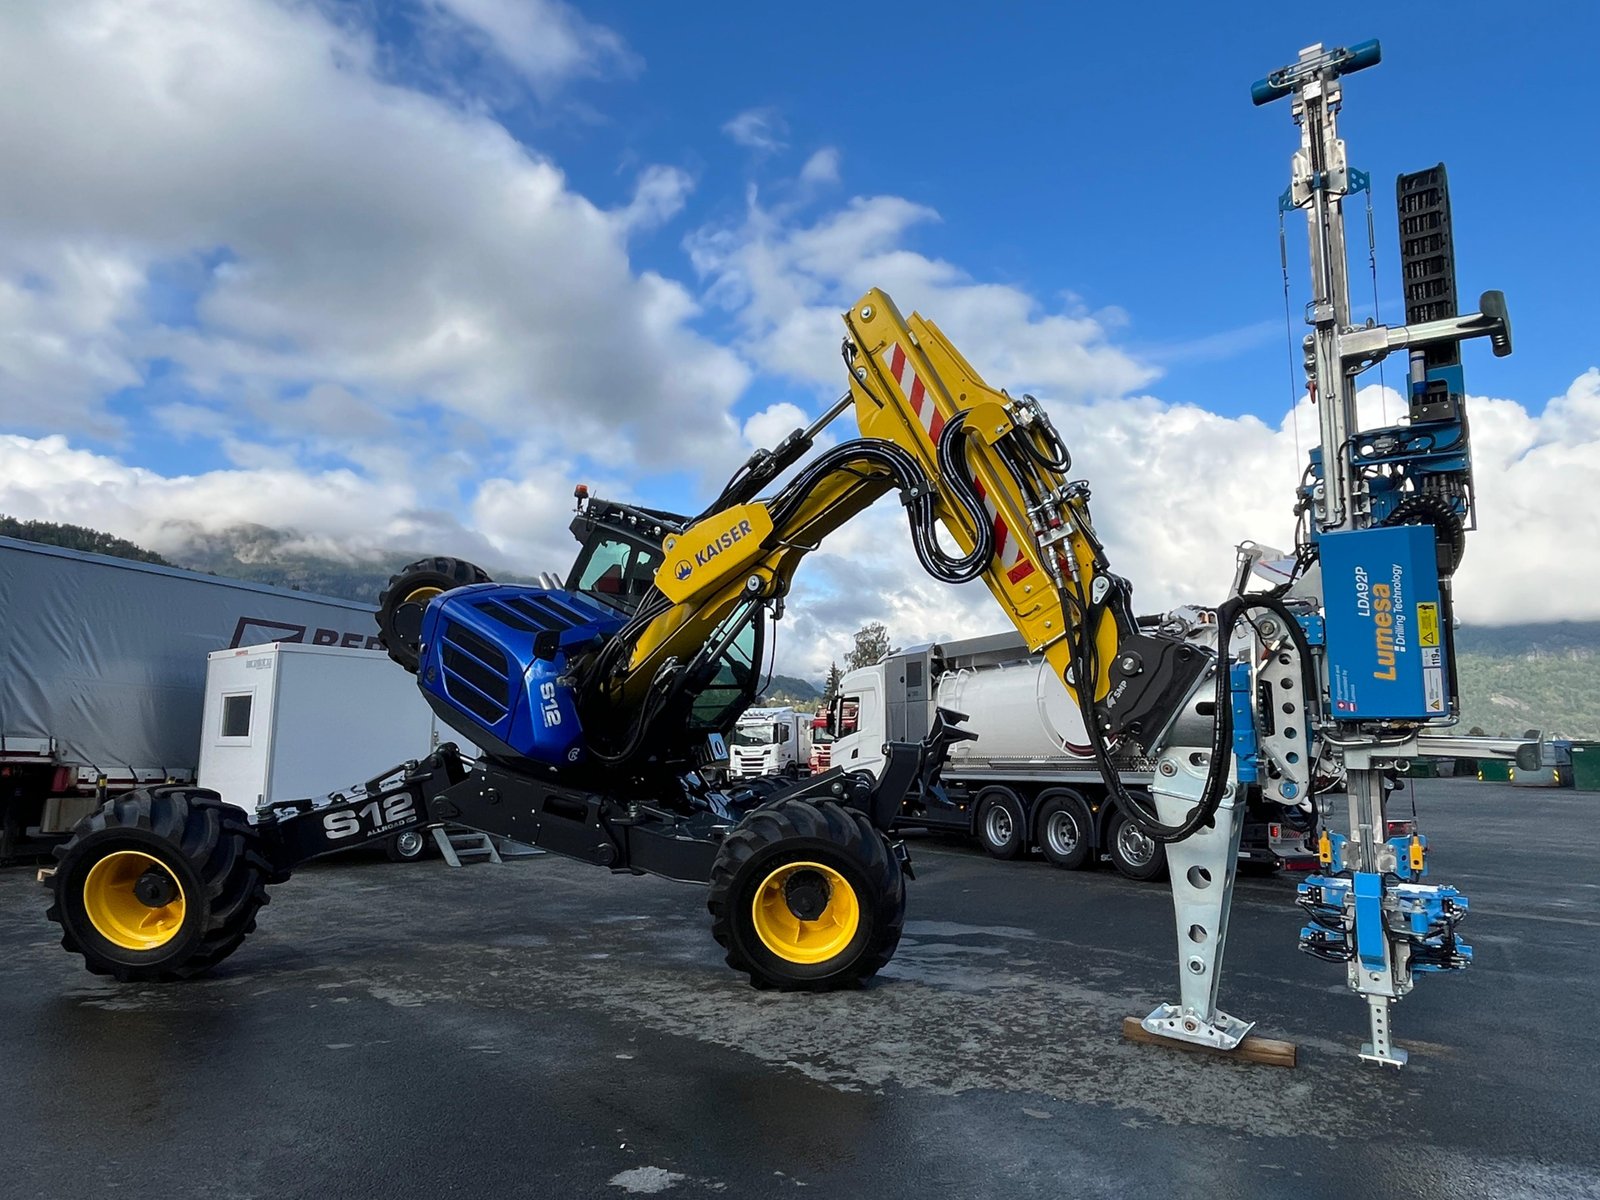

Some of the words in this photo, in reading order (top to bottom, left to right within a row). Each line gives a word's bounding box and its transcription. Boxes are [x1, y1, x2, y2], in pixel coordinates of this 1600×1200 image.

[694, 520, 752, 567] KAISER
[1355, 566, 1371, 617] LDA92P
[1391, 564, 1403, 613] Technology
[1372, 583, 1397, 681] Lumesa
[1395, 614, 1406, 645] Drilling
[1431, 653, 1440, 665] 119
[540, 682, 562, 727] S12
[1113, 680, 1127, 698] SMP
[323, 792, 416, 839] S12
[367, 820, 405, 837] ALLROAD
